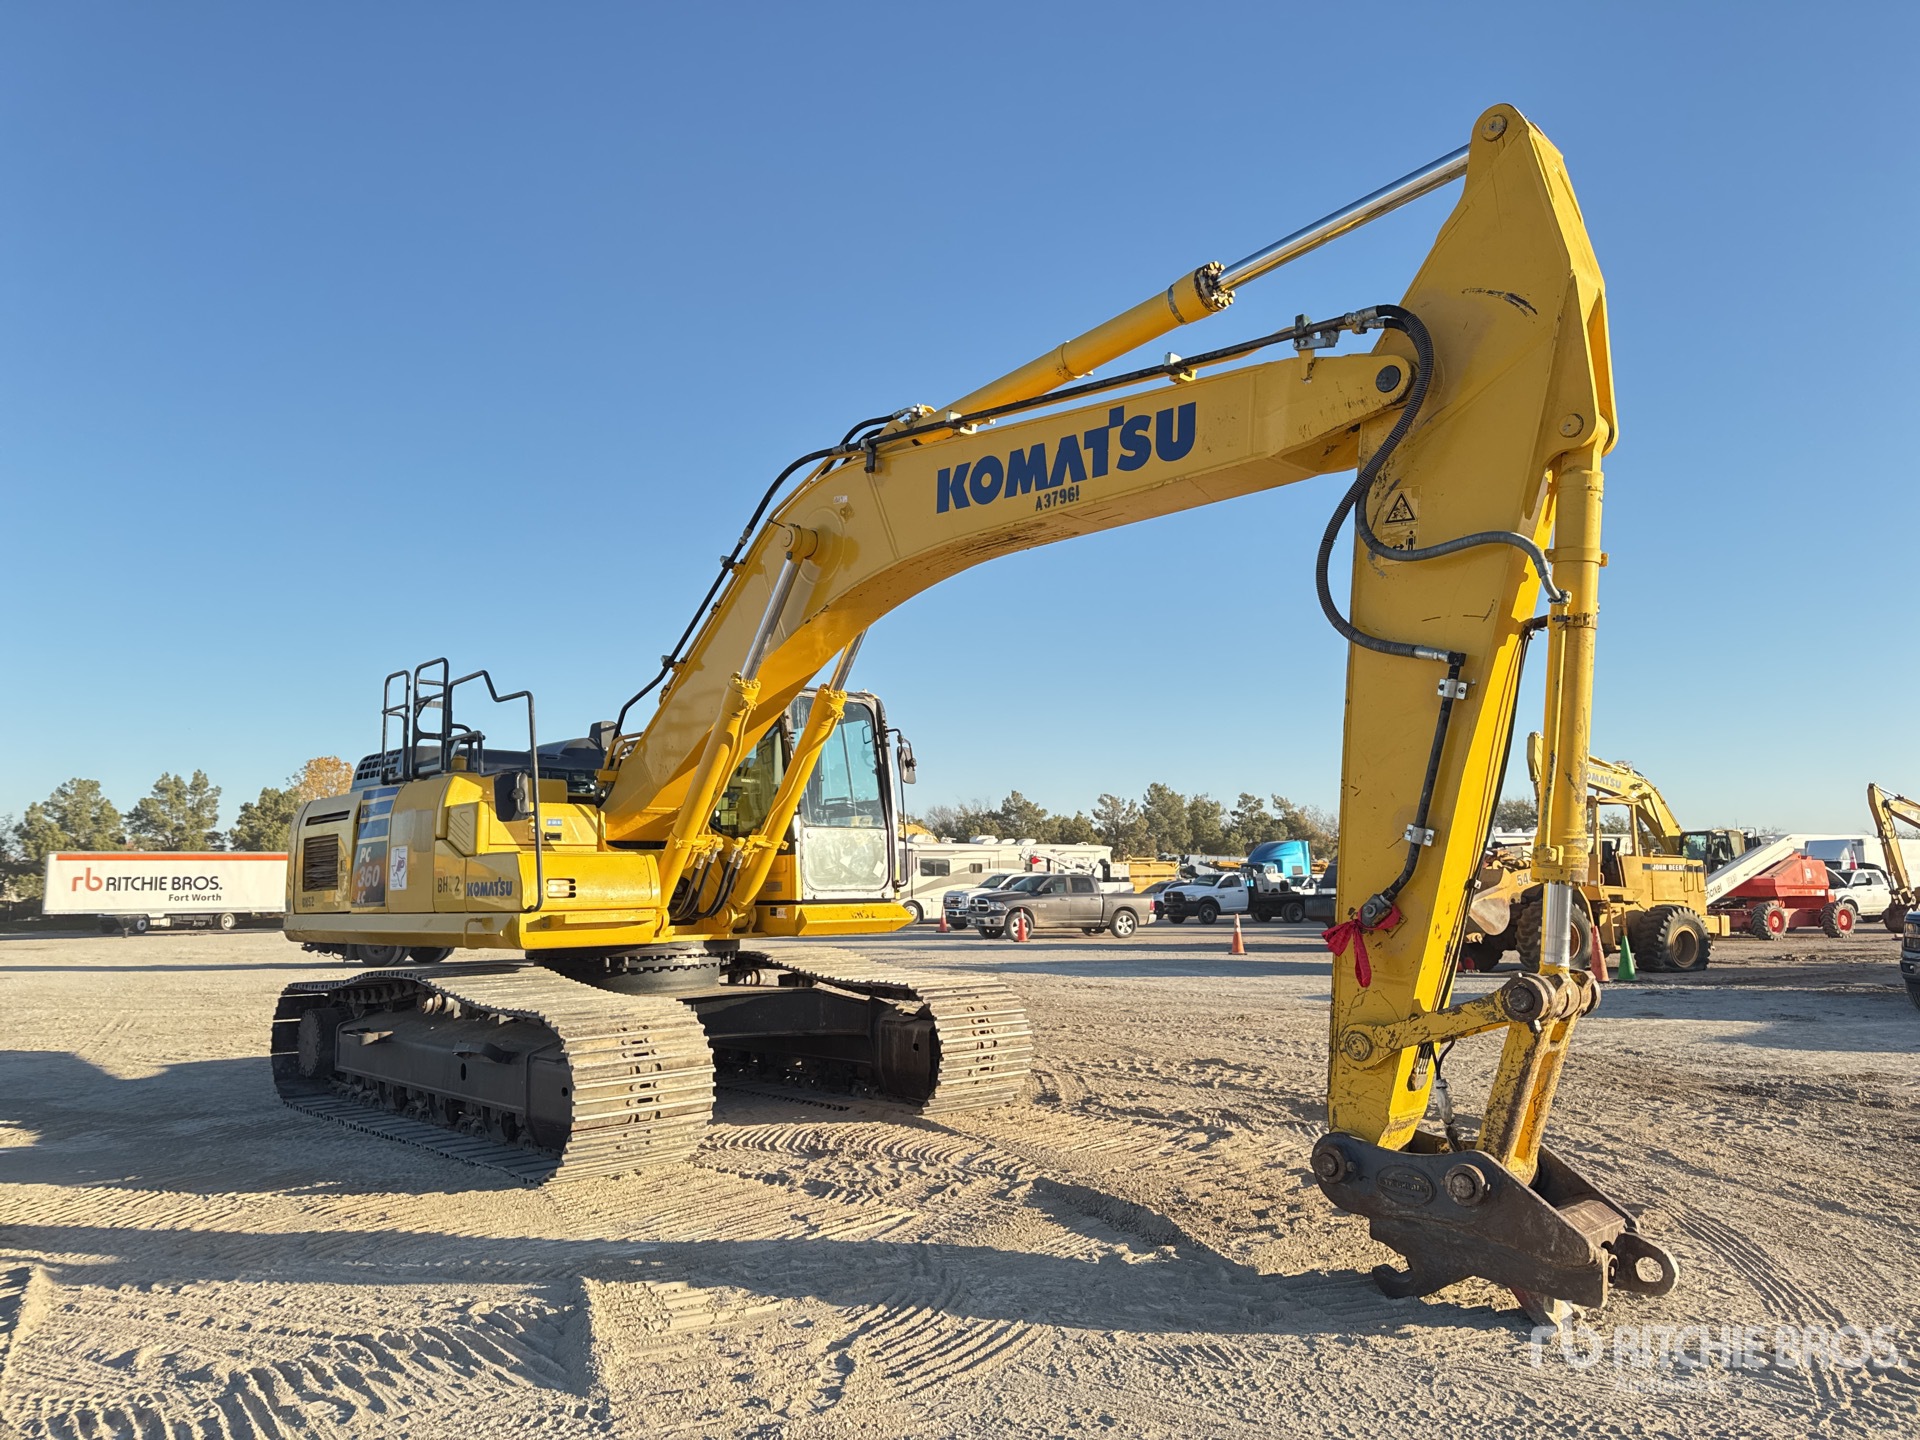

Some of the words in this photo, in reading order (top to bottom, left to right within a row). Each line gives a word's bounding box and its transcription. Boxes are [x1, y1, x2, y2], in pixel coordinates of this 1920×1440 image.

[936, 402, 1197, 514] KOMATSU
[1586, 771, 1622, 789] OMATSU
[360, 846, 372, 863] PC
[71, 867, 103, 892] rb
[105, 876, 168, 892] RITCHIE
[171, 876, 223, 891] BROS.
[357, 865, 380, 888] 360
[437, 876, 461, 893] BH2
[1516, 872, 1532, 887] 54
[466, 877, 513, 897] KOMATSU
[168, 893, 190, 902] Fort
[191, 893, 222, 902] Worth
